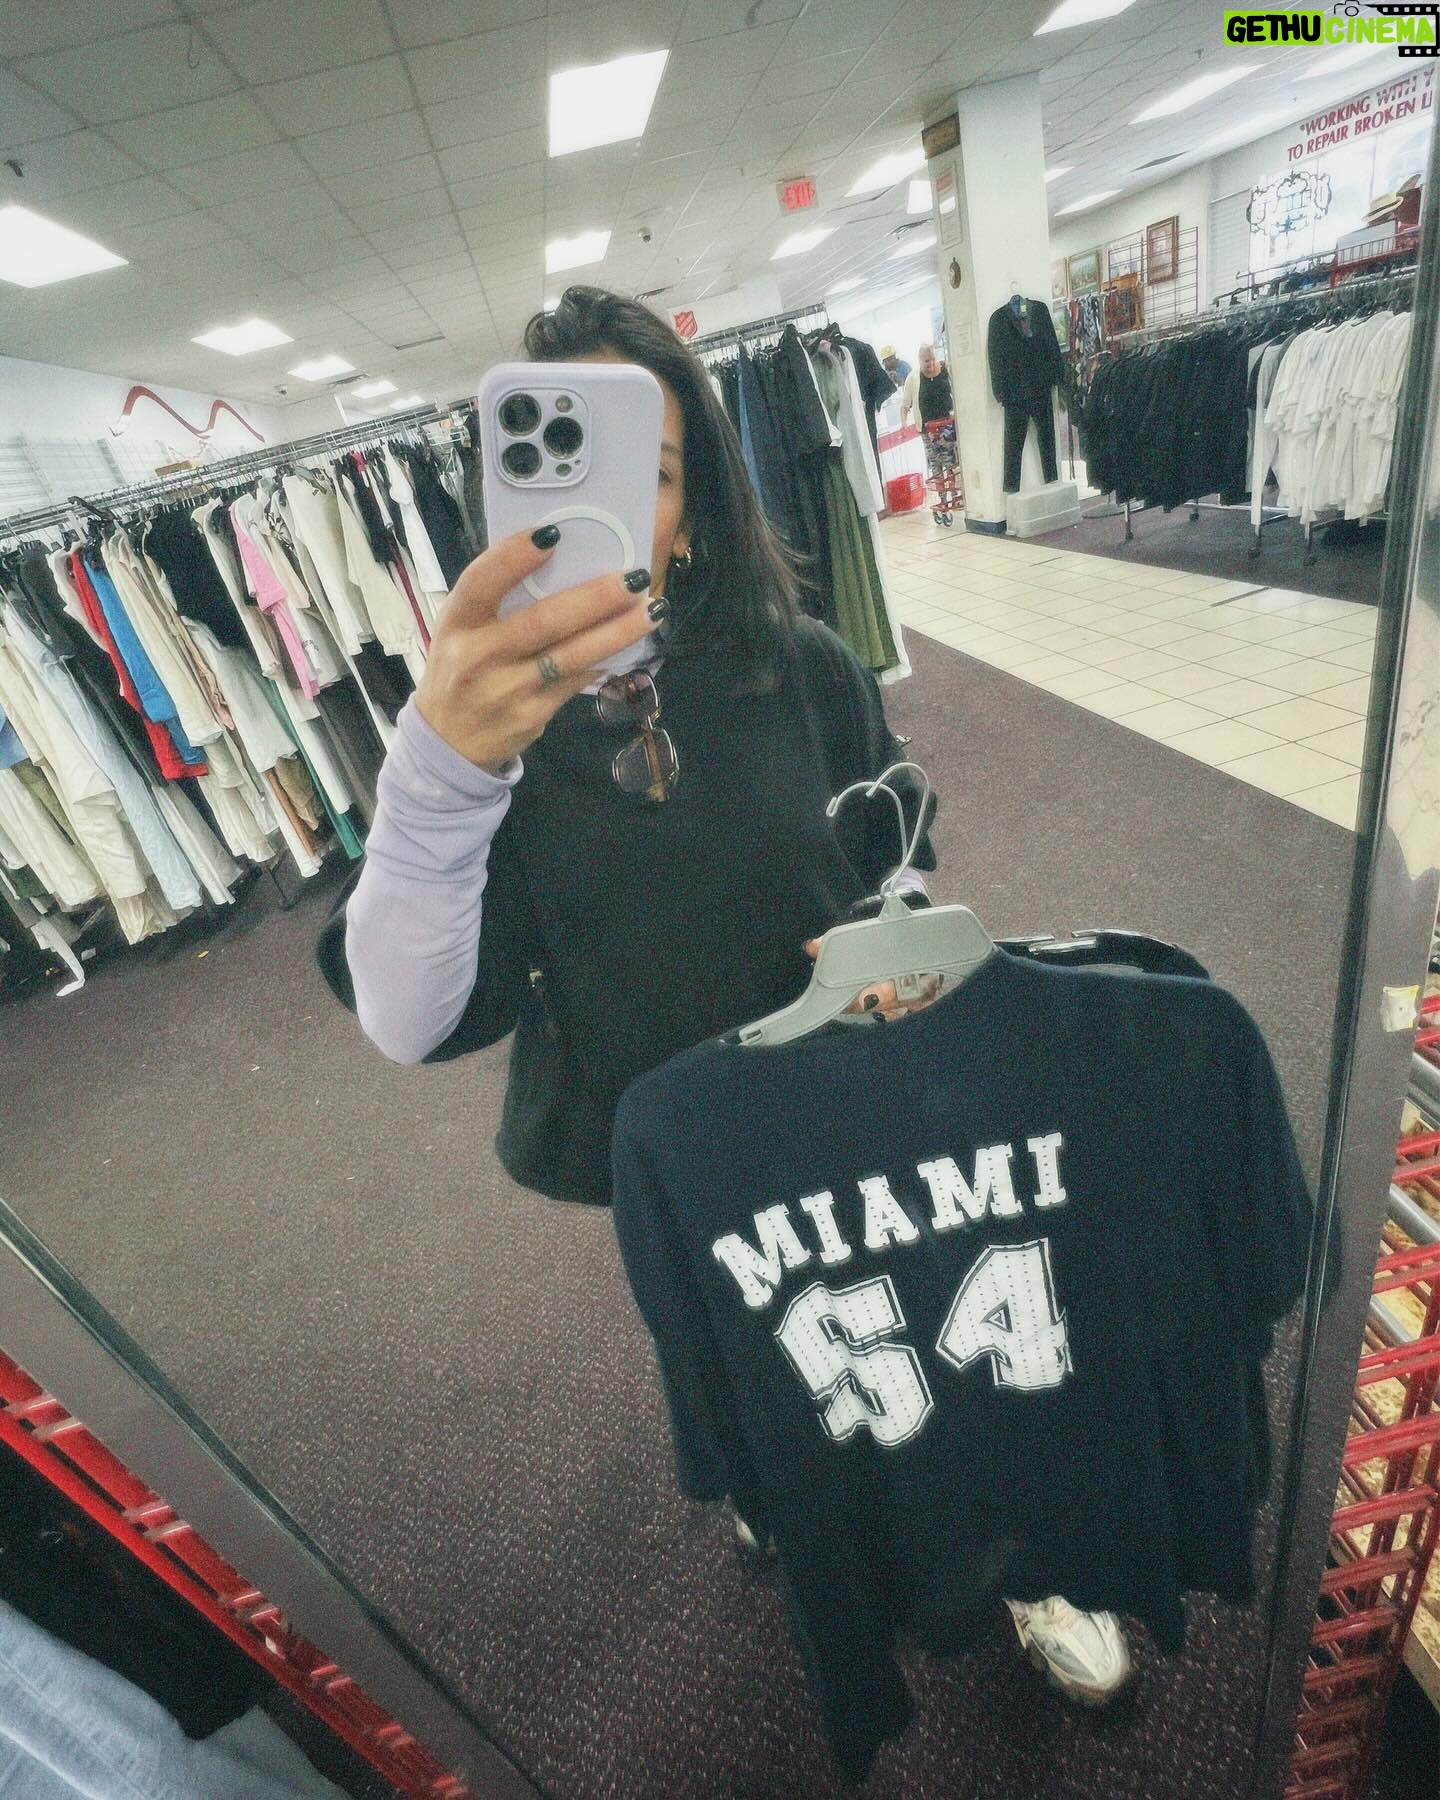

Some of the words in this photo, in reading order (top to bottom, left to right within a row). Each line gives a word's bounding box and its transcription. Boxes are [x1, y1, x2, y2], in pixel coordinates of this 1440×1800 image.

[1287, 143, 1304, 161] TO
[1306, 125, 1349, 154] REPAIR
[1353, 97, 1416, 136] BROKEN
[784, 181, 811, 209] EXIT
[711, 1131, 1068, 1308] MIAMI
